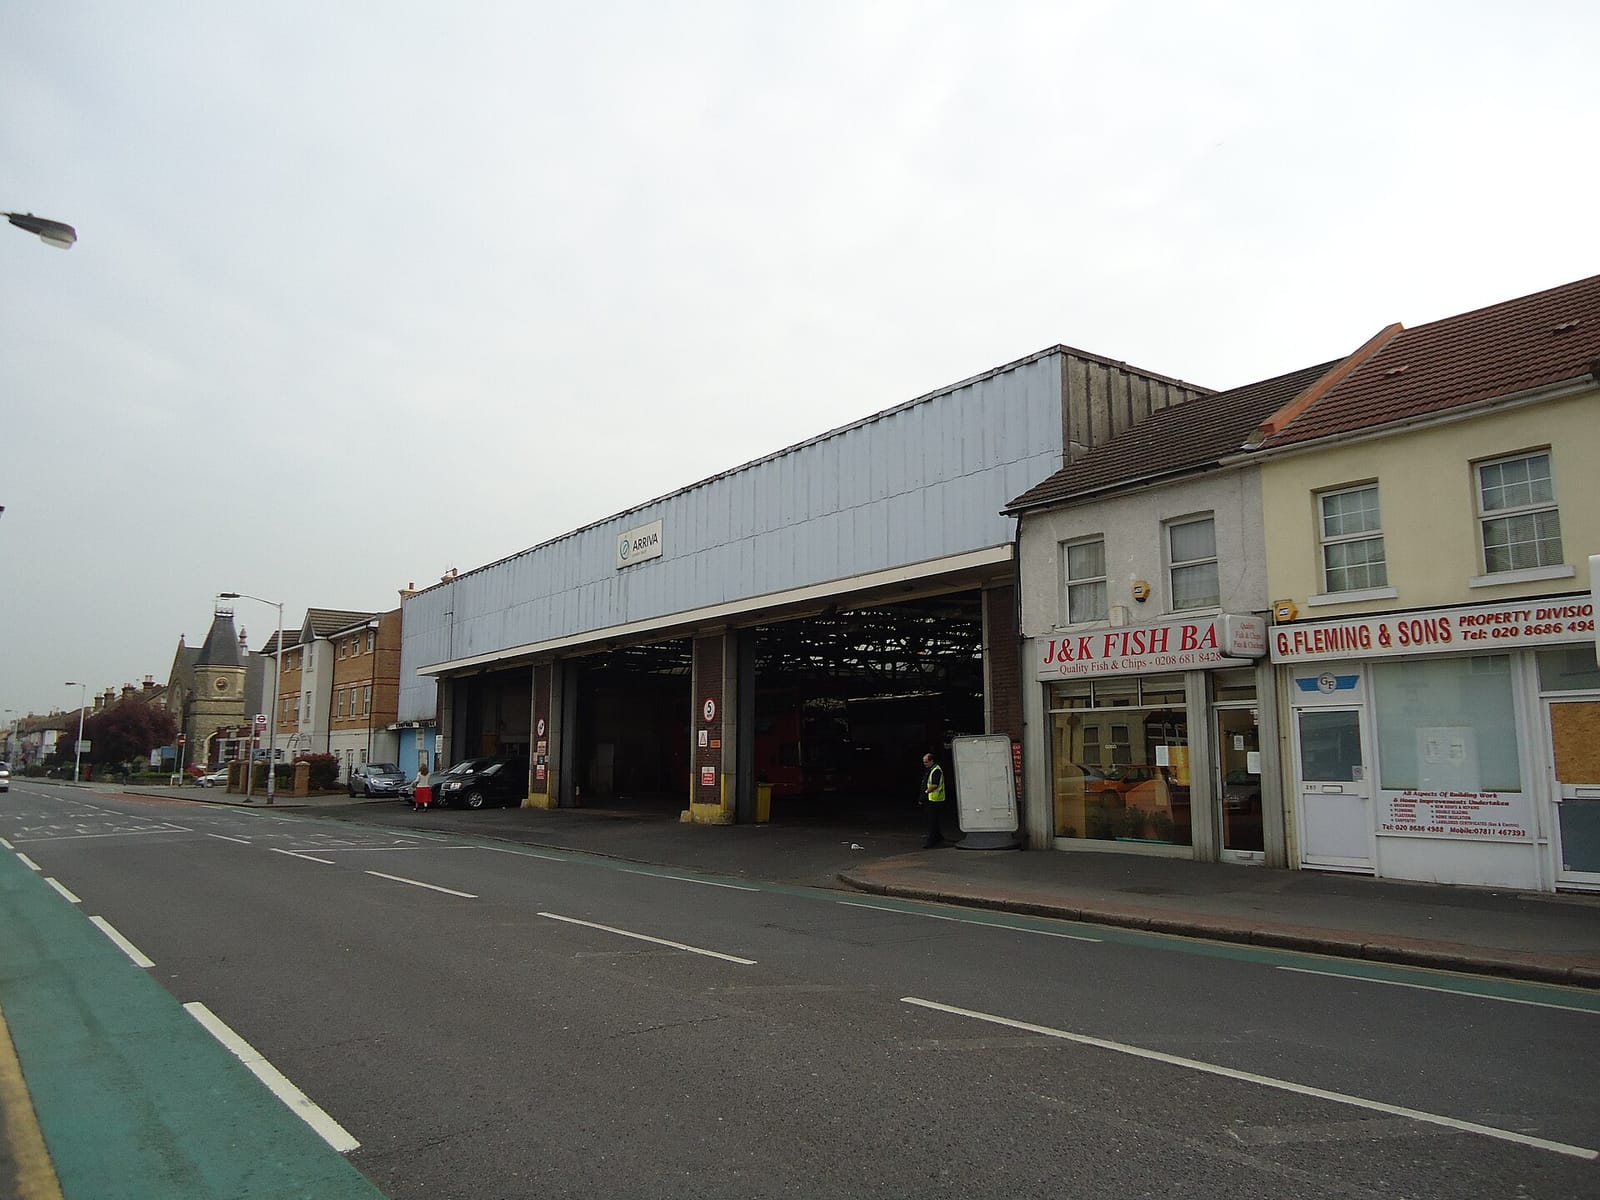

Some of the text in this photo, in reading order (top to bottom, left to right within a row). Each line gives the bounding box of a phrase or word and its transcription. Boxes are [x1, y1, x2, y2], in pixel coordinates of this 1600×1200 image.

[633, 533, 659, 551] ARRIVA
[1459, 604, 1593, 626] PROPERTY DIVISIO
[1276, 616, 1453, 657] G.FLEMING & SONS
[1461, 628, 1488, 640] Tel:
[1492, 626, 1519, 638] 020
[1524, 622, 1563, 636] 8686
[1043, 622, 1219, 664] J&K FISH BA
[1060, 663, 1088, 675] Quality
[1091, 661, 1109, 671] Fish
[1111, 660, 1119, 669] &
[1121, 658, 1147, 670] Chips
[1155, 655, 1176, 665] 0208
[1179, 653, 1195, 664] 681
[1199, 652, 1222, 662] 8428
[1449, 791, 1477, 799] Building
